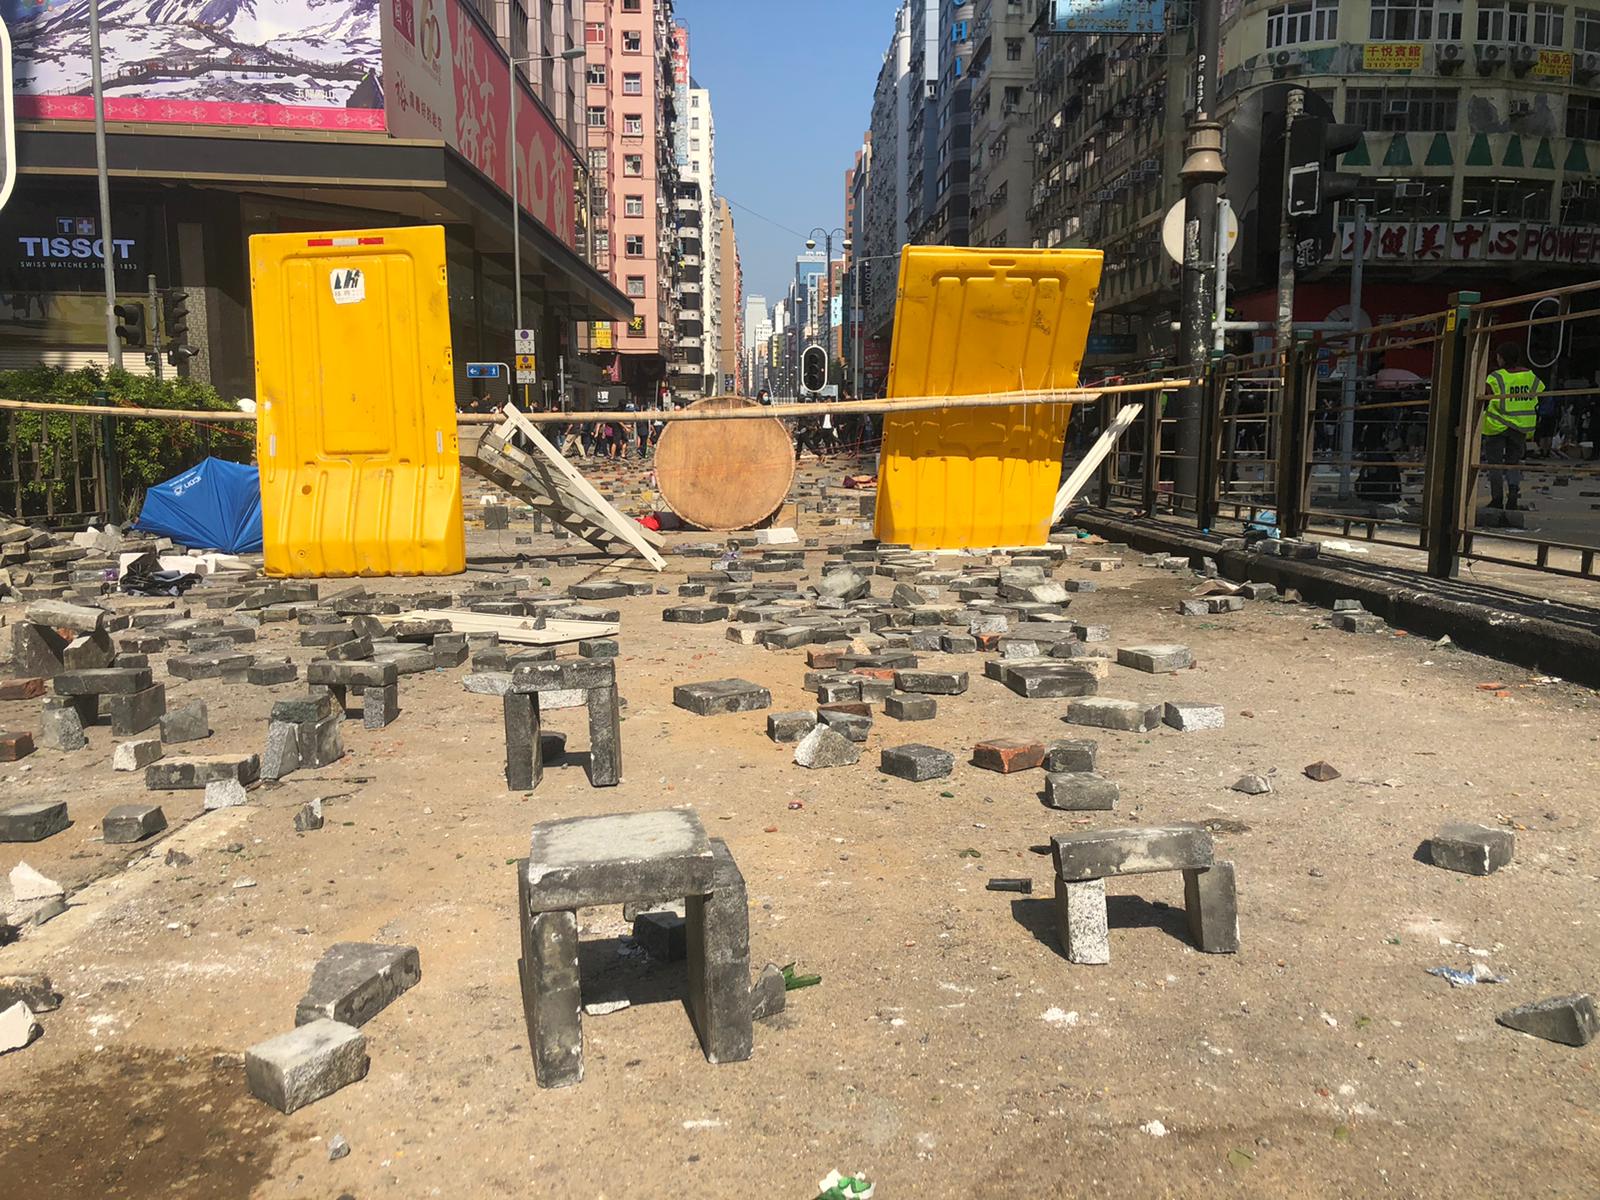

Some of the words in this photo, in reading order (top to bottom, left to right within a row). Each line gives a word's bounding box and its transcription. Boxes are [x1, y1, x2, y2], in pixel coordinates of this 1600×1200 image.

[18, 237, 136, 259] TISSOT
[1326, 224, 1519, 259] 力健美中心
